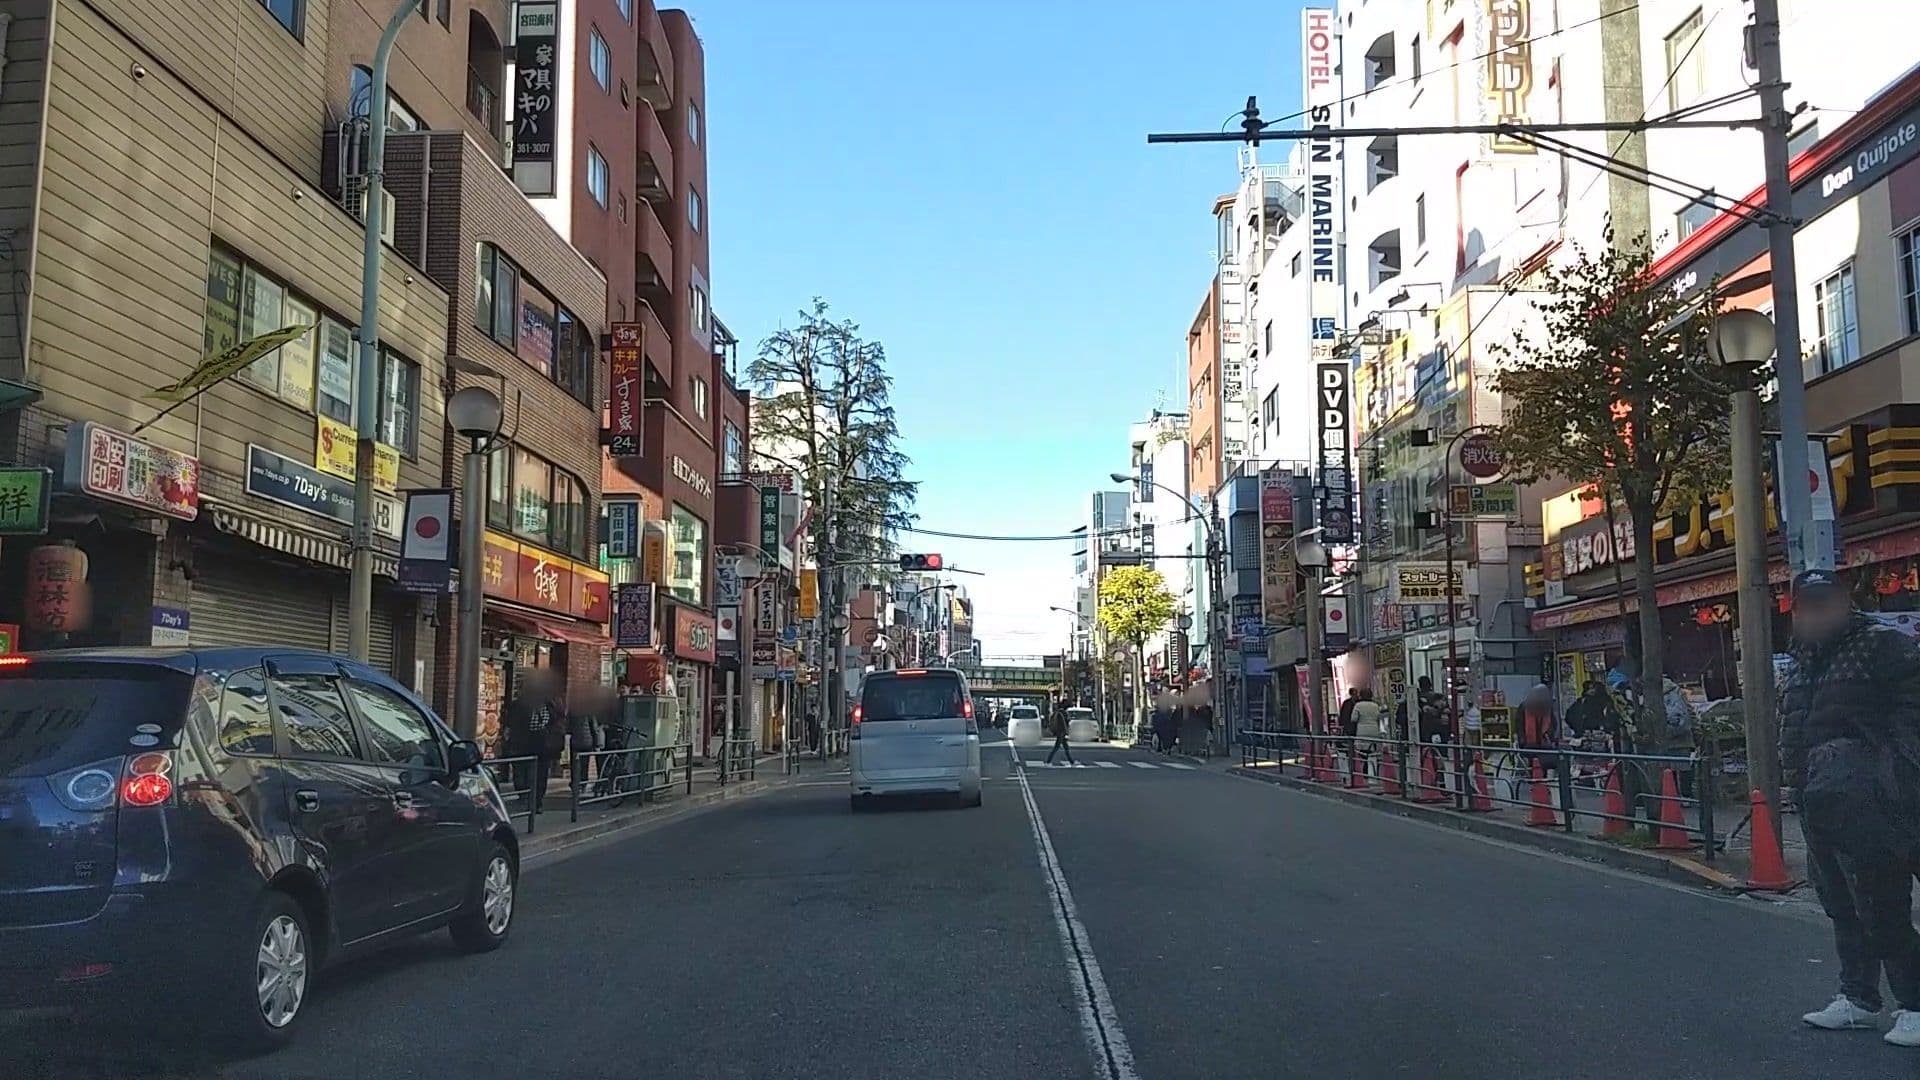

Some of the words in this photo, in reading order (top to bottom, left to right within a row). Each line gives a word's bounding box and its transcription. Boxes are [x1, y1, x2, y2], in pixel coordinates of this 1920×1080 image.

[1309, 14, 1330, 89] HOTEL
[535, 44, 553, 112] 家具の
[518, 67, 538, 136] マキバ
[1821, 165, 1854, 199] Don
[1856, 122, 1917, 171] Quijote
[1311, 174, 1333, 283] MARINE
[613, 363, 639, 375] カレー
[616, 376, 636, 433] すき家
[332, 427, 357, 447] Curren
[612, 435, 632, 450] 24
[1463, 447, 1502, 465] 消火栓
[91, 462, 123, 493] 印刷
[293, 475, 328, 502] 7Day's
[1472, 487, 1482, 499] P
[0, 486, 32, 522] 祥
[532, 554, 559, 605] すき家
[581, 584, 600, 615] カレー
[161, 613, 182, 627] 7Day's
[1390, 683, 1405, 694] 30
